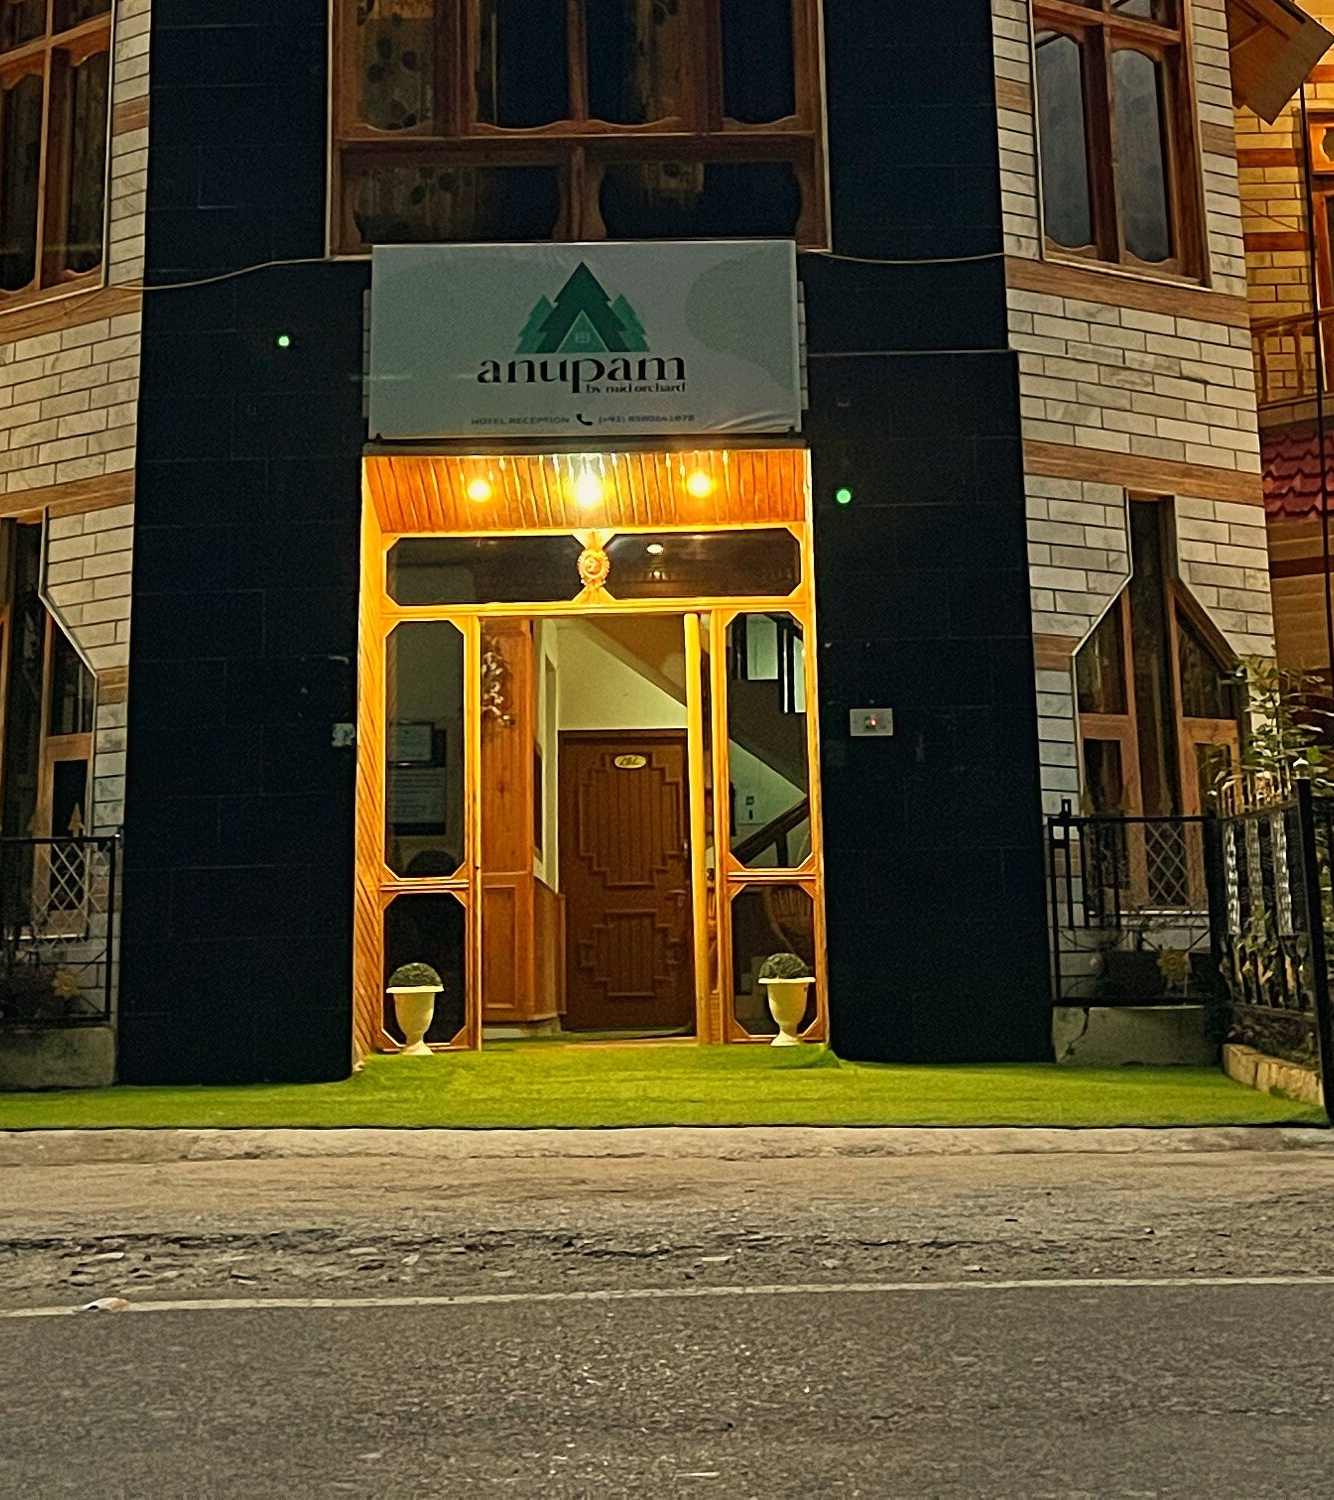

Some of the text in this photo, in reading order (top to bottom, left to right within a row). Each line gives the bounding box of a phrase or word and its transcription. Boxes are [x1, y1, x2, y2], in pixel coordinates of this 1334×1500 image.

[477, 357, 686, 393] anupam
[471, 417, 507, 425] HOTEL
[509, 416, 570, 425] RECEPTION
